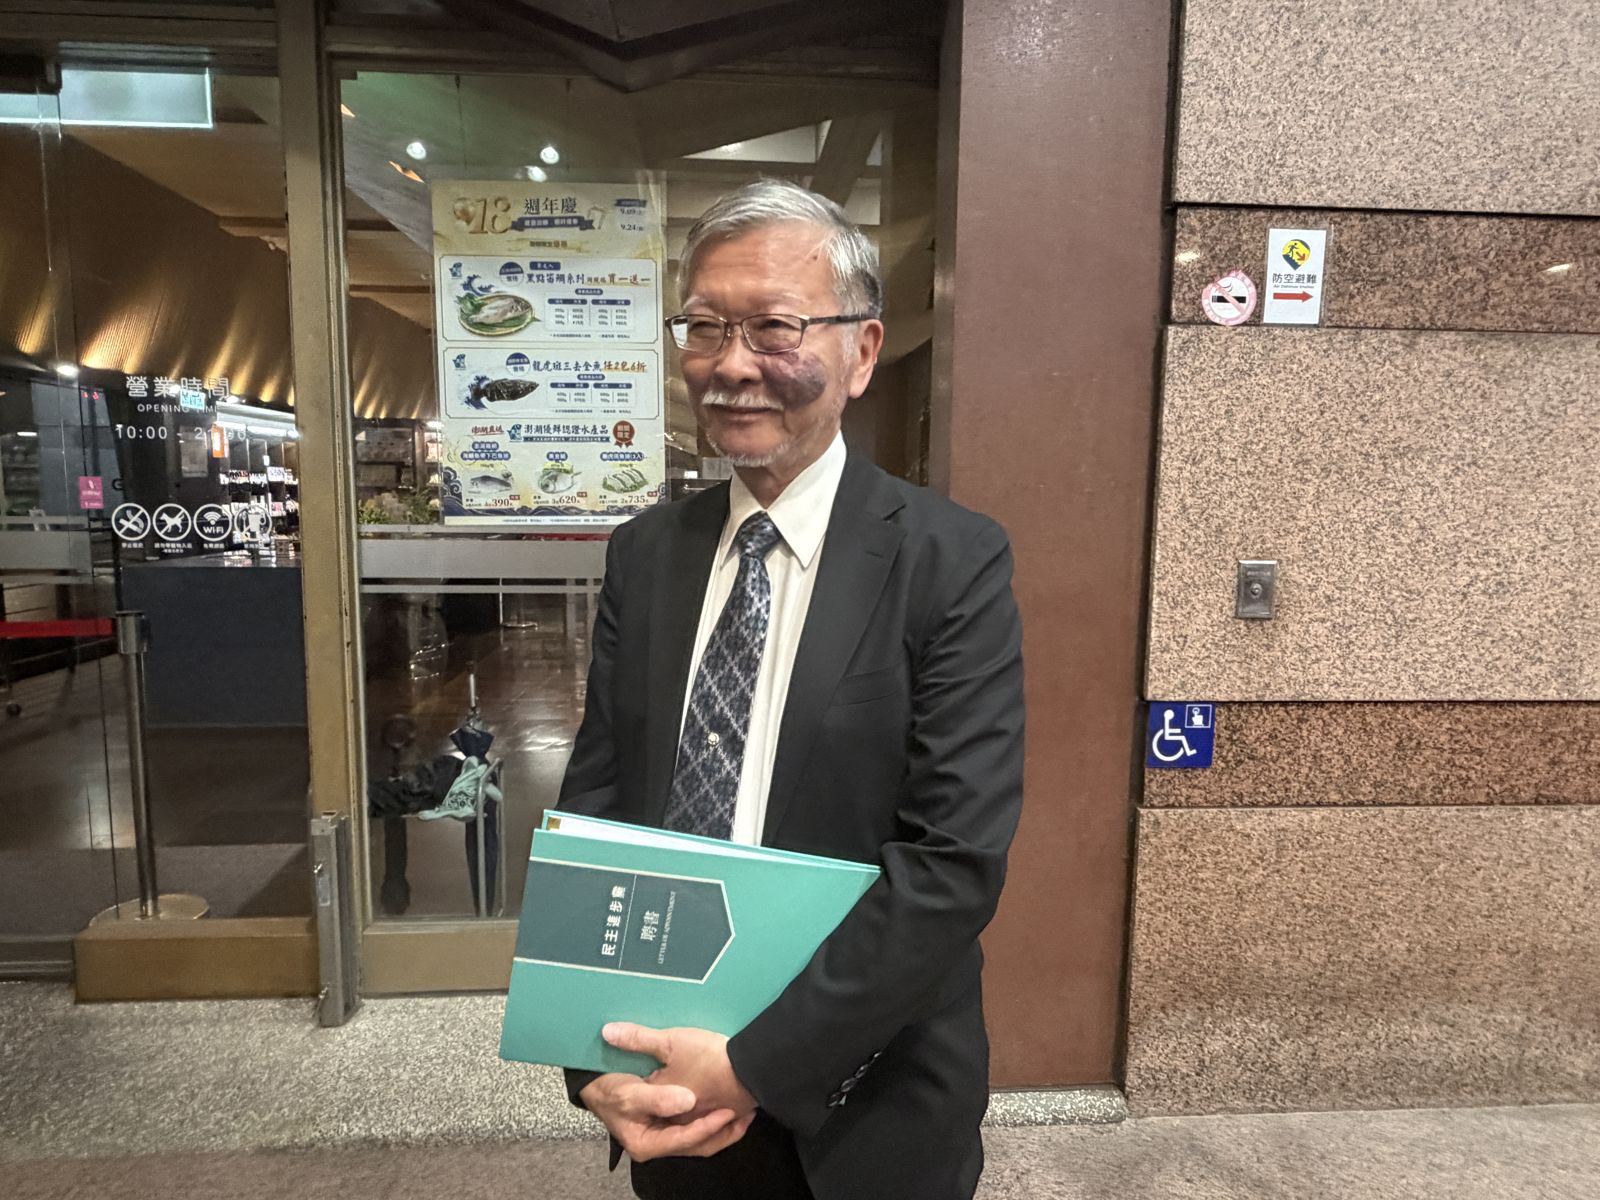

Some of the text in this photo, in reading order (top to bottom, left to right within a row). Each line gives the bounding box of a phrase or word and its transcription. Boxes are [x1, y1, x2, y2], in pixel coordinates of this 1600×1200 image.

[524, 196, 577, 215] 週年慶
[1272, 273, 1317, 284] 防空避難
[125, 376, 230, 399] 營業時間
[137, 403, 190, 413] OPENING
[116, 425, 168, 440] 10:00
[524, 424, 609, 435] 澎湖優鮮認證水產品
[601, 885, 626, 957] 民主進步黨
[639, 910, 660, 941] 聘書
